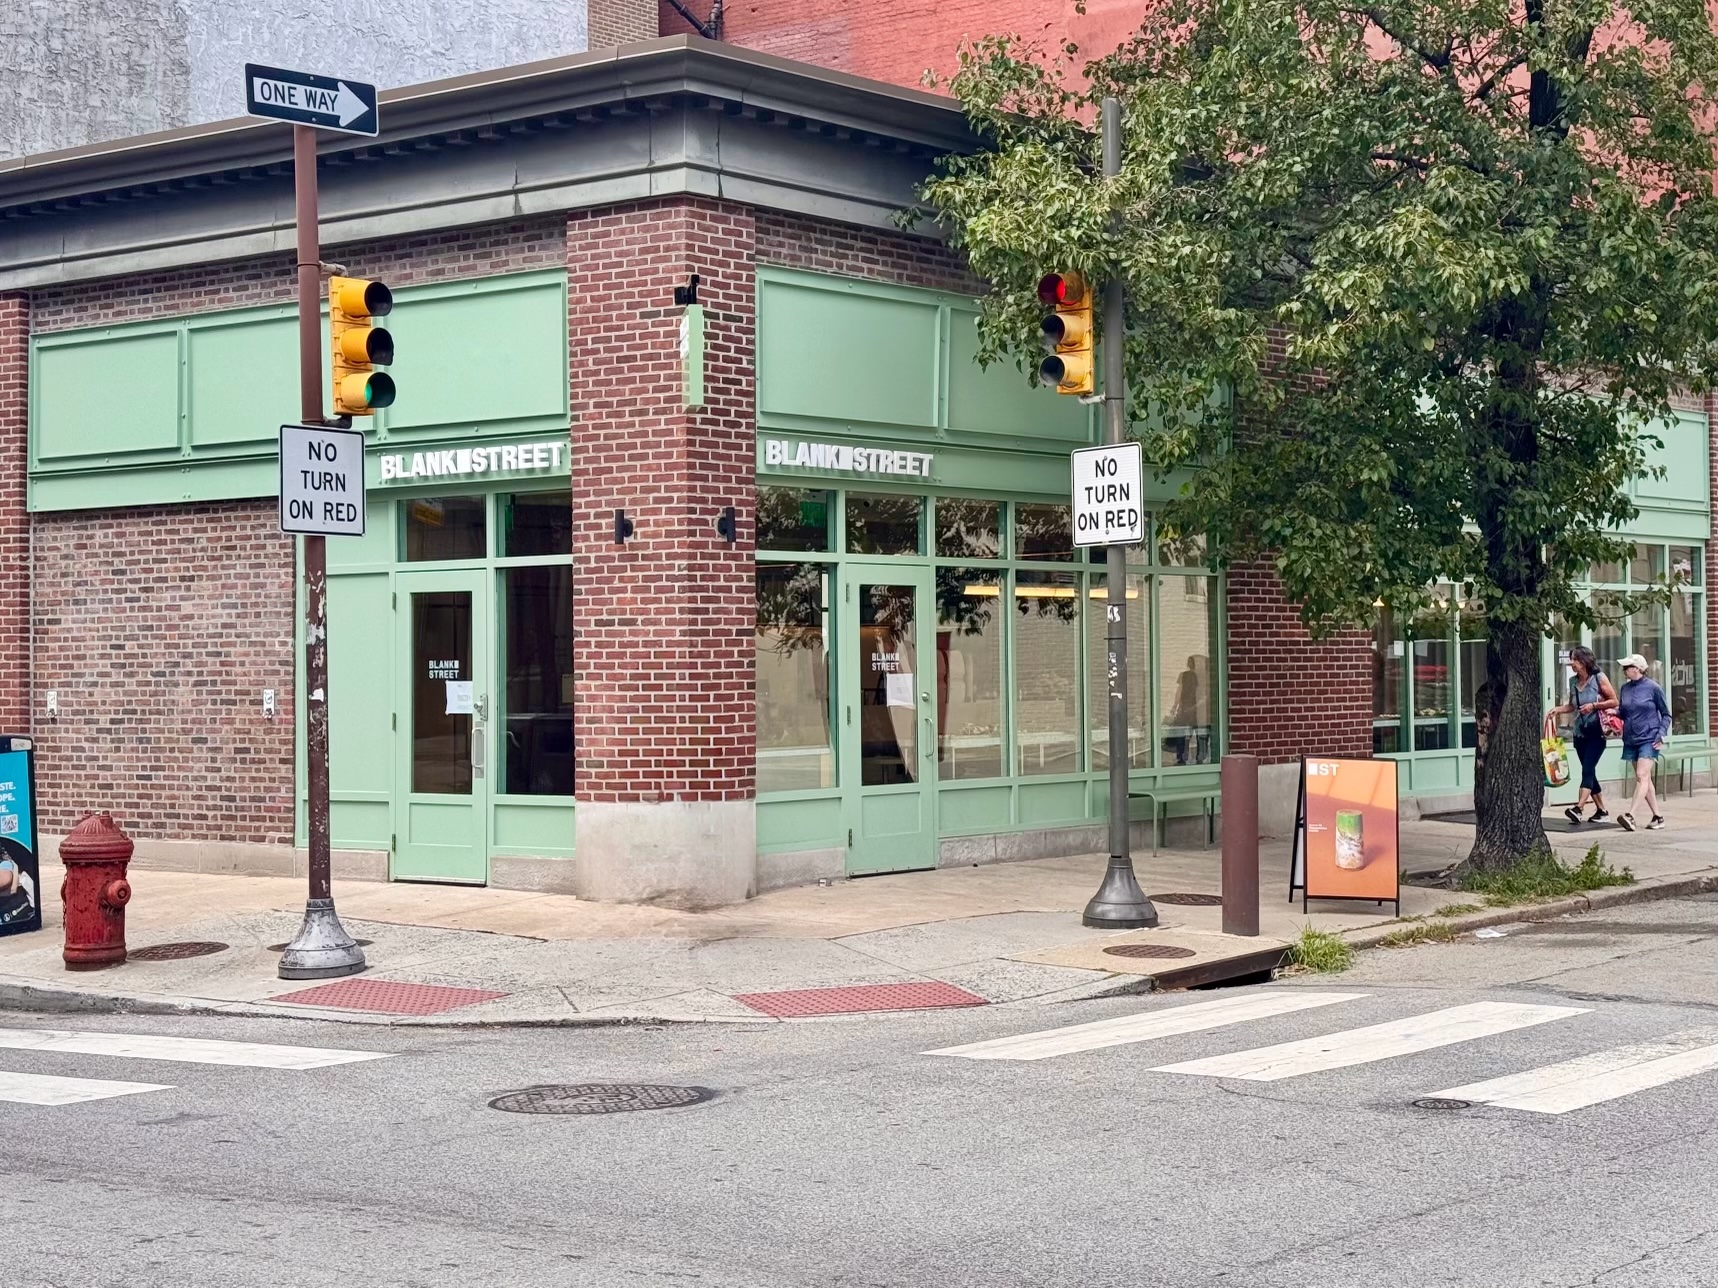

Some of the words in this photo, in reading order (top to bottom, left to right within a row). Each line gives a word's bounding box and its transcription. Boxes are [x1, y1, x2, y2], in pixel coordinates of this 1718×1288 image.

[261, 81, 299, 106] ONE
[304, 88, 339, 112] WAY
[308, 441, 337, 462] NO
[380, 449, 457, 479] BLANK
[472, 441, 563, 473] STREET
[765, 439, 841, 469] BLANK
[853, 447, 934, 477] STREET
[1095, 458, 1118, 478] NO
[300, 470, 346, 493] TURN
[1084, 482, 1130, 505] TURN
[289, 499, 313, 520] ON
[323, 501, 357, 523] RED
[1078, 511, 1099, 531] ON
[1105, 508, 1138, 529] RED
[428, 660, 455, 669] BLANK
[871, 652, 895, 661] BLANK
[871, 662, 900, 671] STREET
[428, 669, 460, 679] STREET
